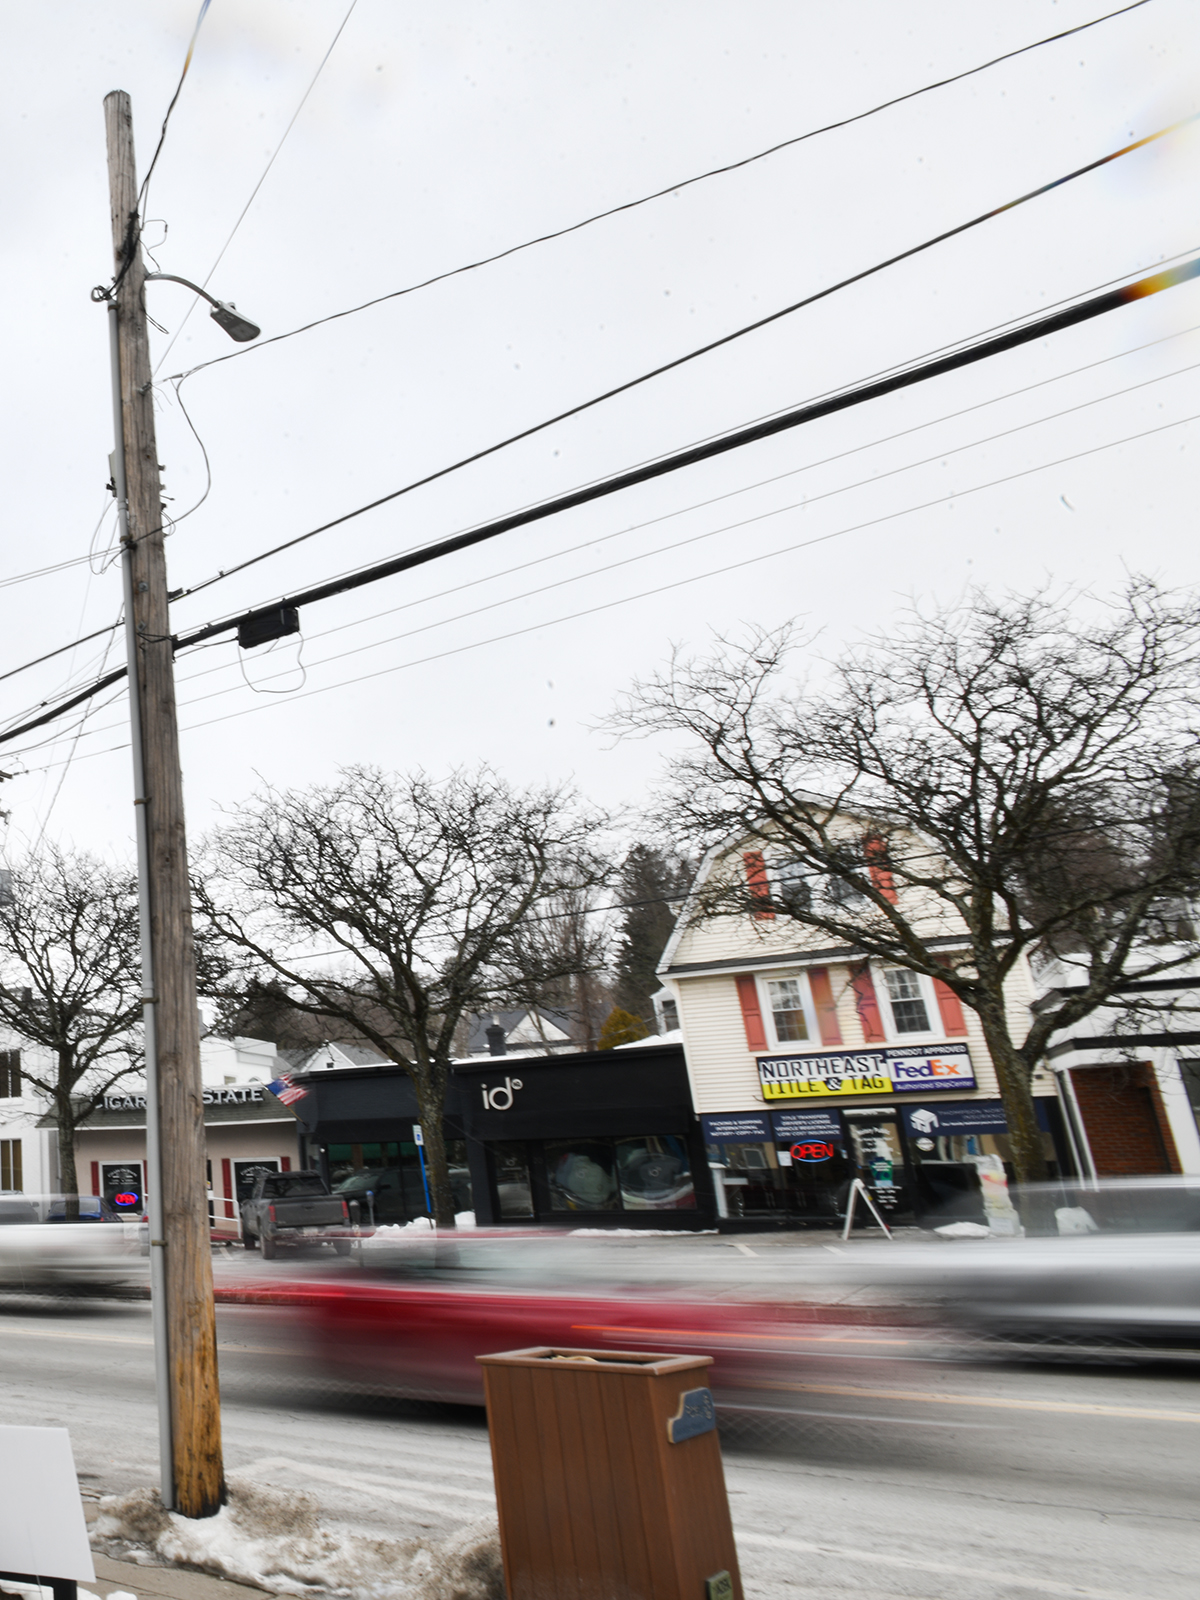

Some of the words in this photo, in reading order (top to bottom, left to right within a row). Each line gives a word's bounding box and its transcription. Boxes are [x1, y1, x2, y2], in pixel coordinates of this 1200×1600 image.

[924, 1045, 966, 1055] APPROVED
[761, 1055, 882, 1078] NORTHEAST
[893, 1059, 961, 1078] FedEx
[765, 1078, 820, 1094] TITLE
[826, 1077, 842, 1091] &
[848, 1074, 884, 1090] TAG
[935, 1081, 973, 1089] ShipCenter
[481, 1077, 513, 1110] id
[790, 1143, 834, 1159] OPEN
[115, 1193, 136, 1205] OPEN
